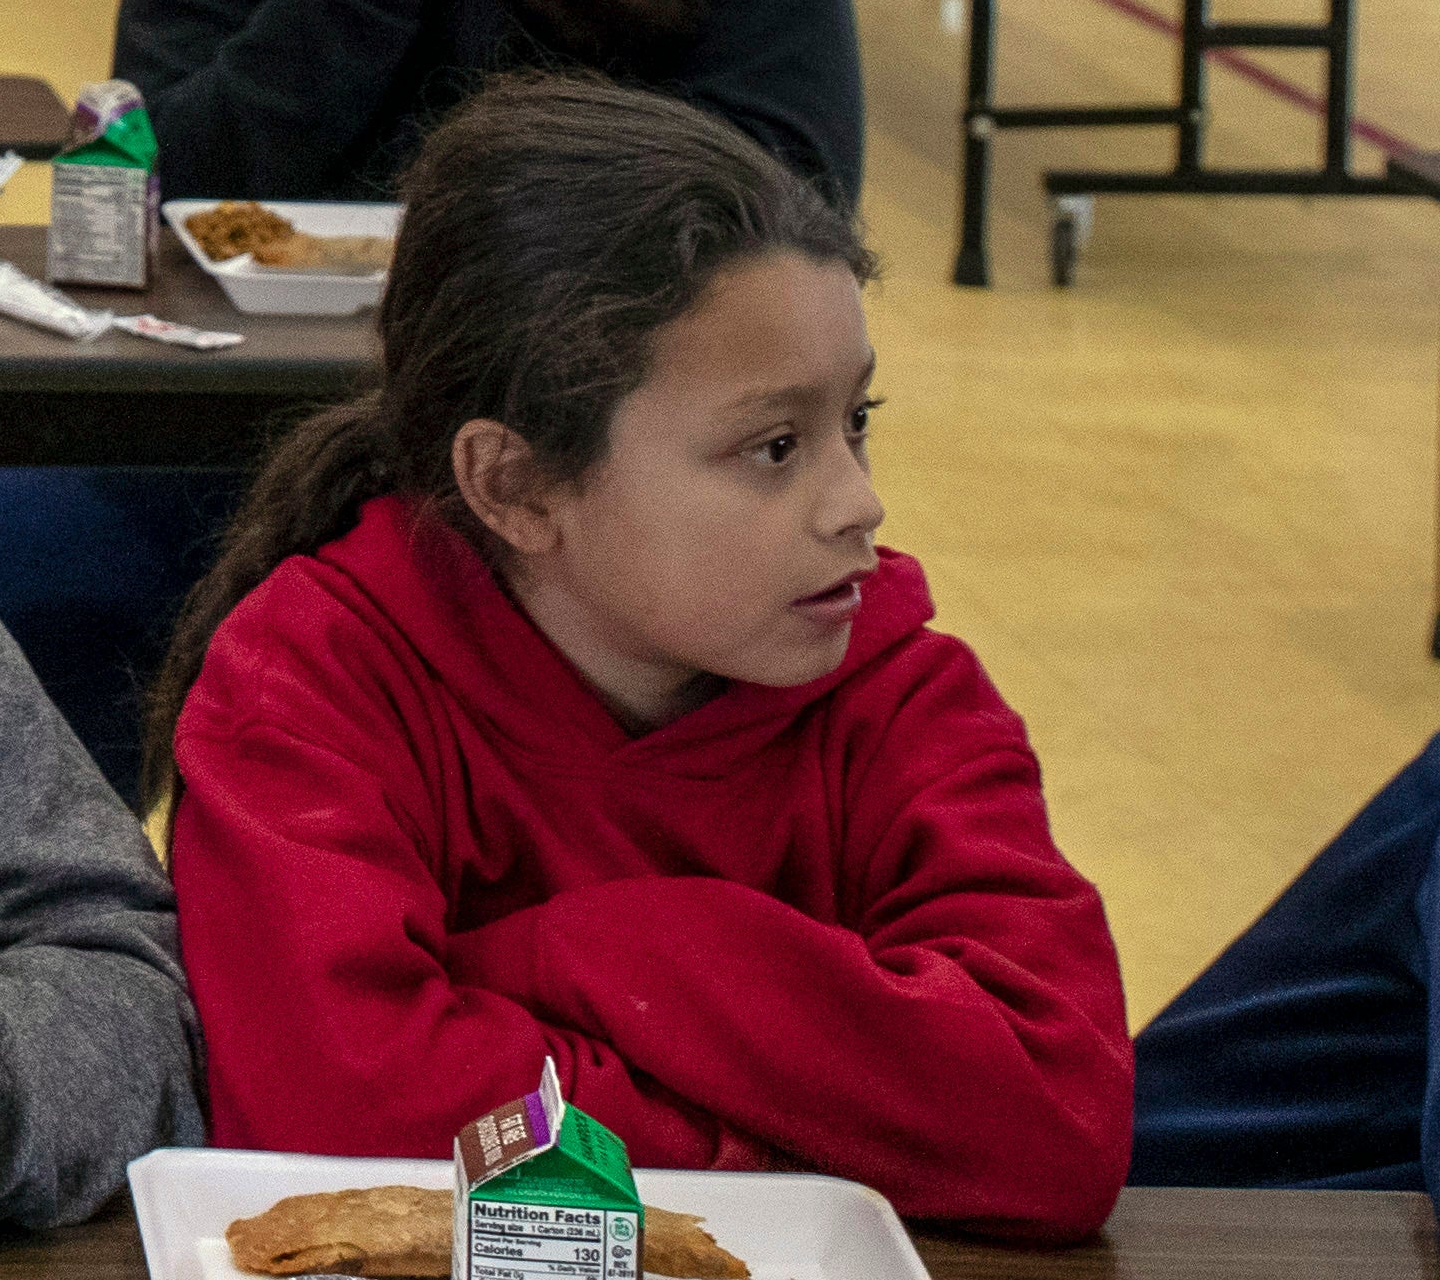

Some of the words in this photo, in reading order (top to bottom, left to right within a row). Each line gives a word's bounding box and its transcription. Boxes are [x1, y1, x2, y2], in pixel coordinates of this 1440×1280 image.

[474, 1203, 549, 1221] Nutrition
[555, 1210, 600, 1225] Facts
[474, 1220, 505, 1233] Serving
[538, 1225, 564, 1234] Carton
[474, 1243, 523, 1256] Calories
[574, 1248, 600, 1261] 130
[474, 1266, 495, 1277] Total
